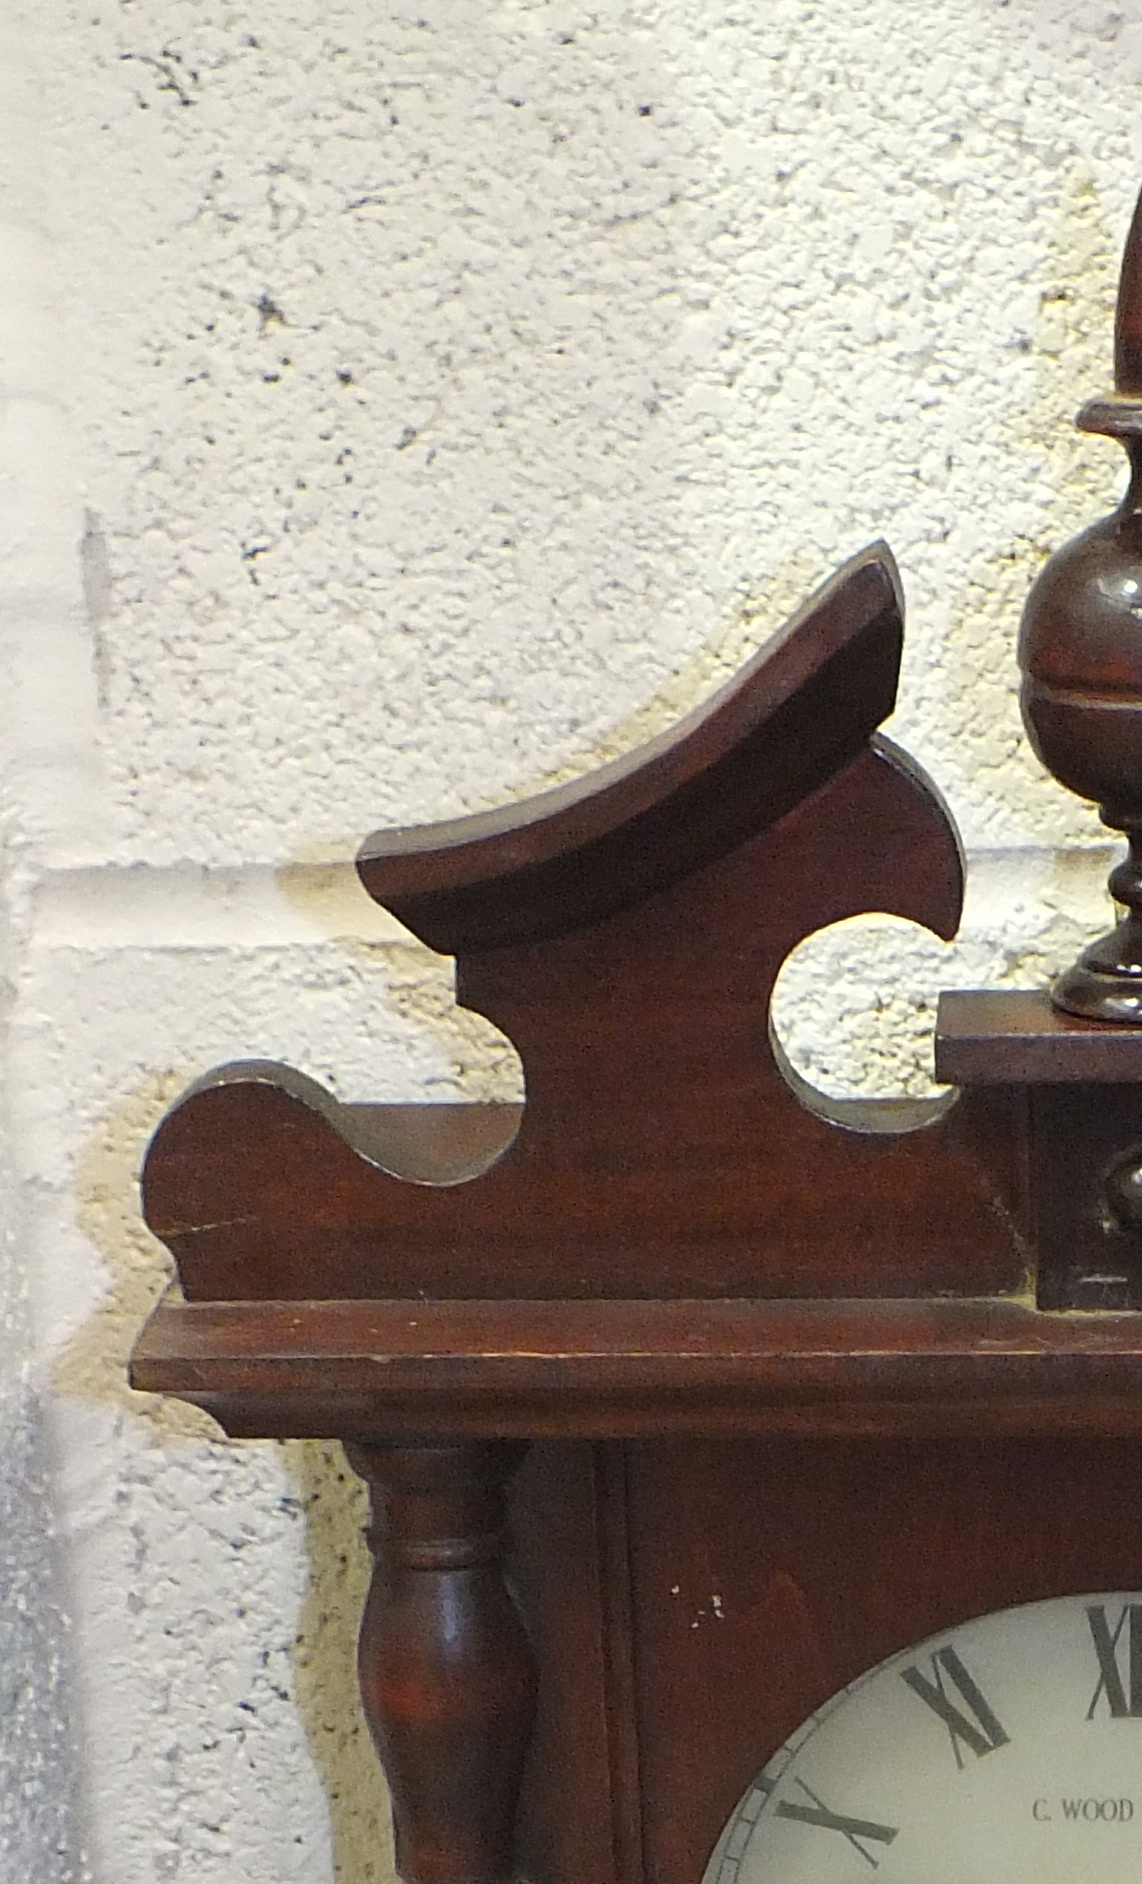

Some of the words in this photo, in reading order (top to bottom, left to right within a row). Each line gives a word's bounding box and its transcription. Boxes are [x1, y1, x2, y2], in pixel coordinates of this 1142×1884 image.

[900, 1645, 1011, 1770] XI
[775, 1777, 898, 1869] X
[1062, 1798, 1134, 1822] WOOD
